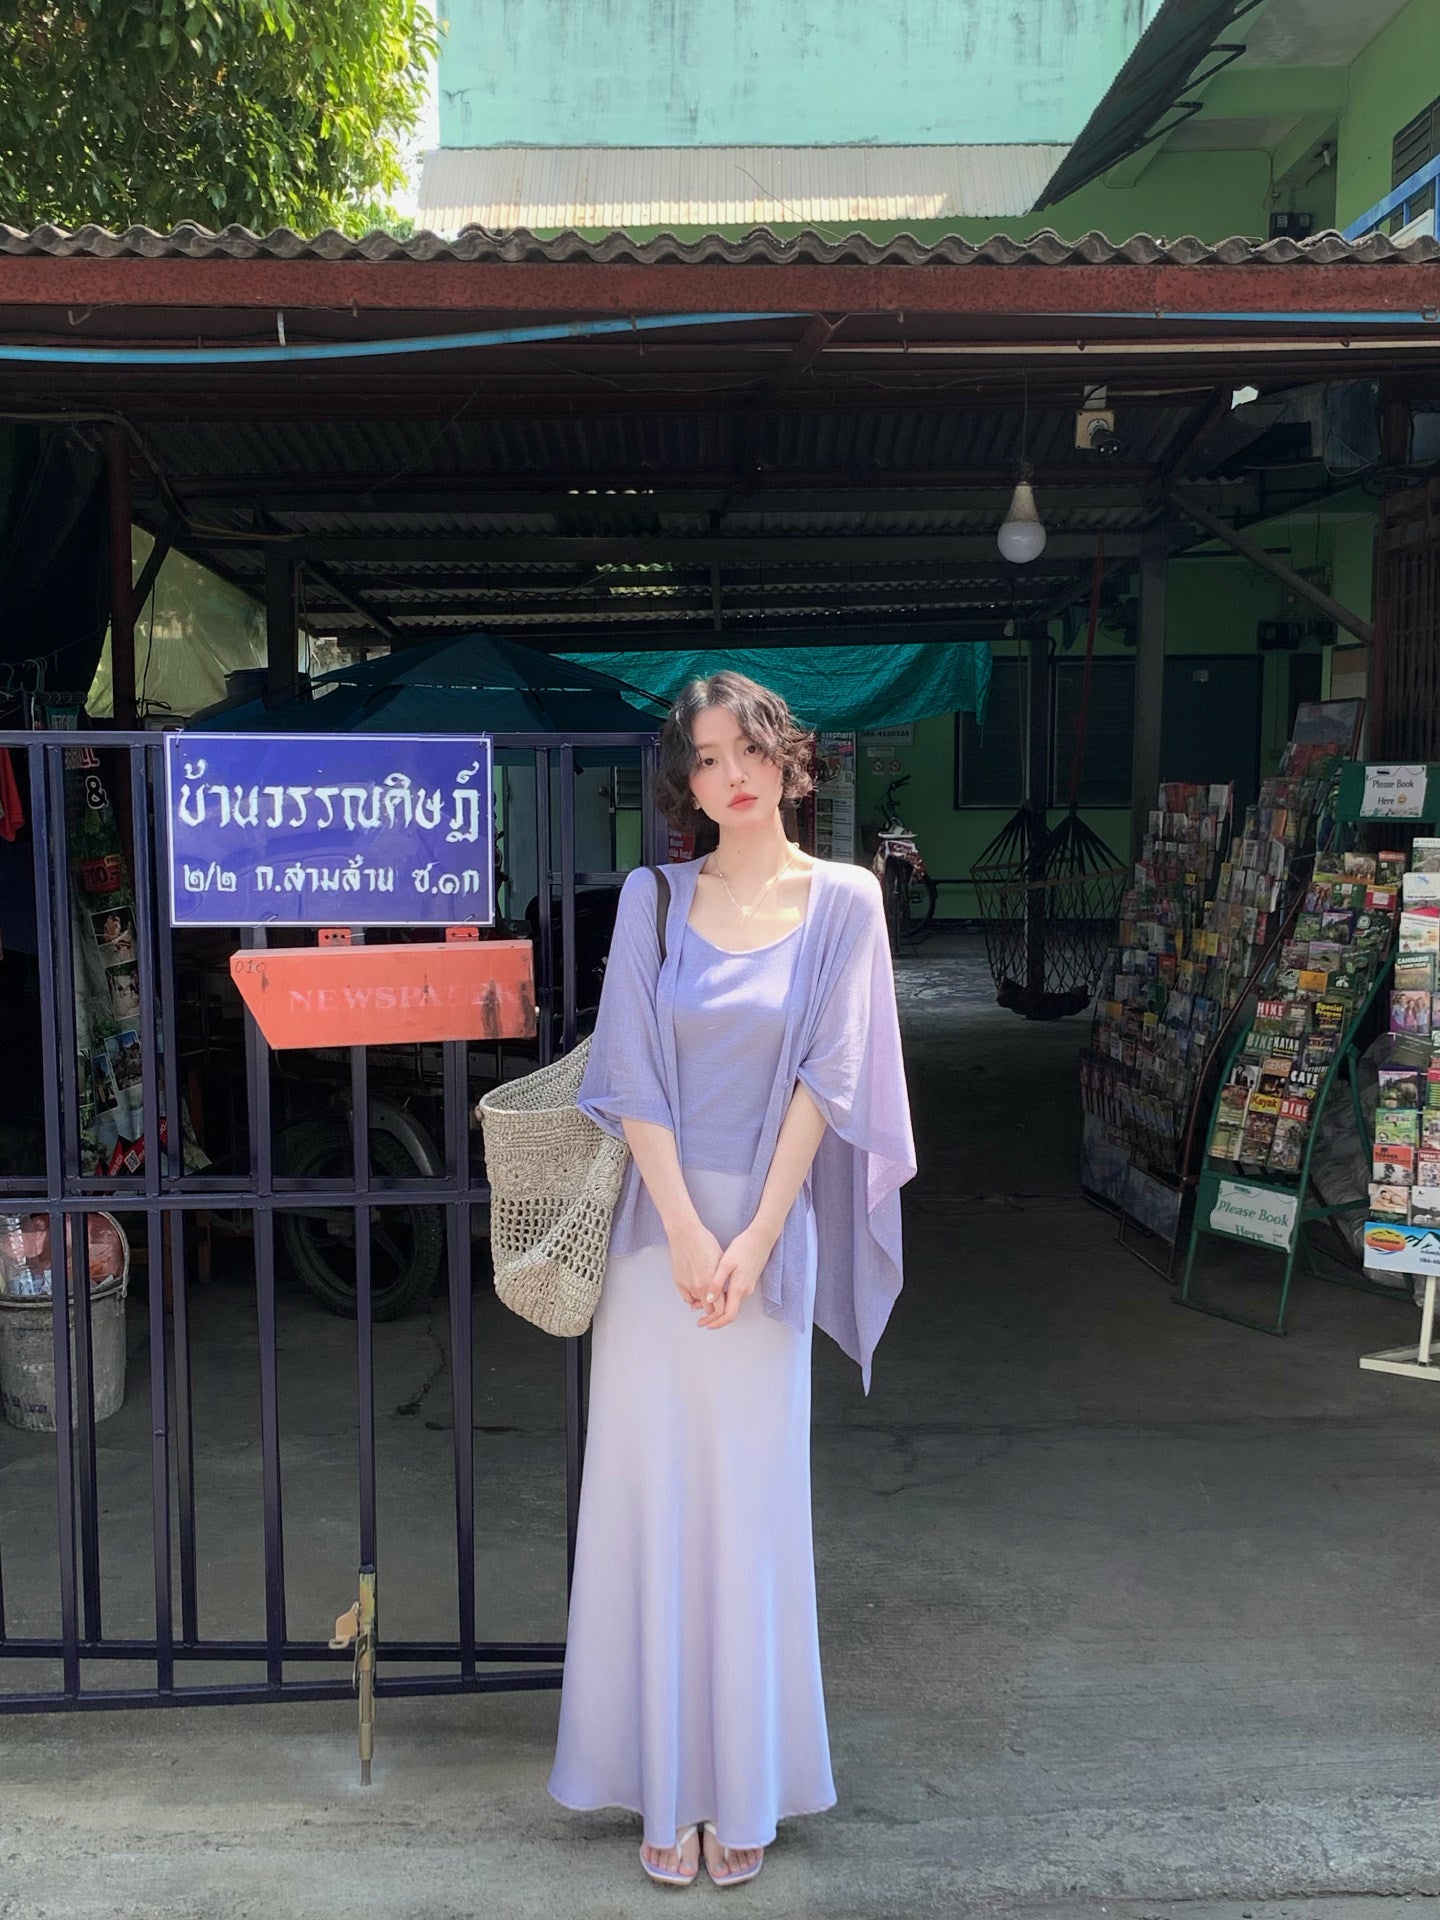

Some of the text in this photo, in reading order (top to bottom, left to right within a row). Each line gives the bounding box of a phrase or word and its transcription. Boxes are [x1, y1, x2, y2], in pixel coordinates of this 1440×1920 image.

[1372, 779, 1415, 789] Please Book
[1378, 797, 1396, 805] Here
[1315, 1002, 1344, 1013] Special
[1290, 1069, 1320, 1086] CAVE
[1252, 1095, 1278, 1109] Kayak
[1281, 1101, 1308, 1118] BIKE
[1217, 1201, 1290, 1227] Please Book
[1235, 1225, 1265, 1241] Here
